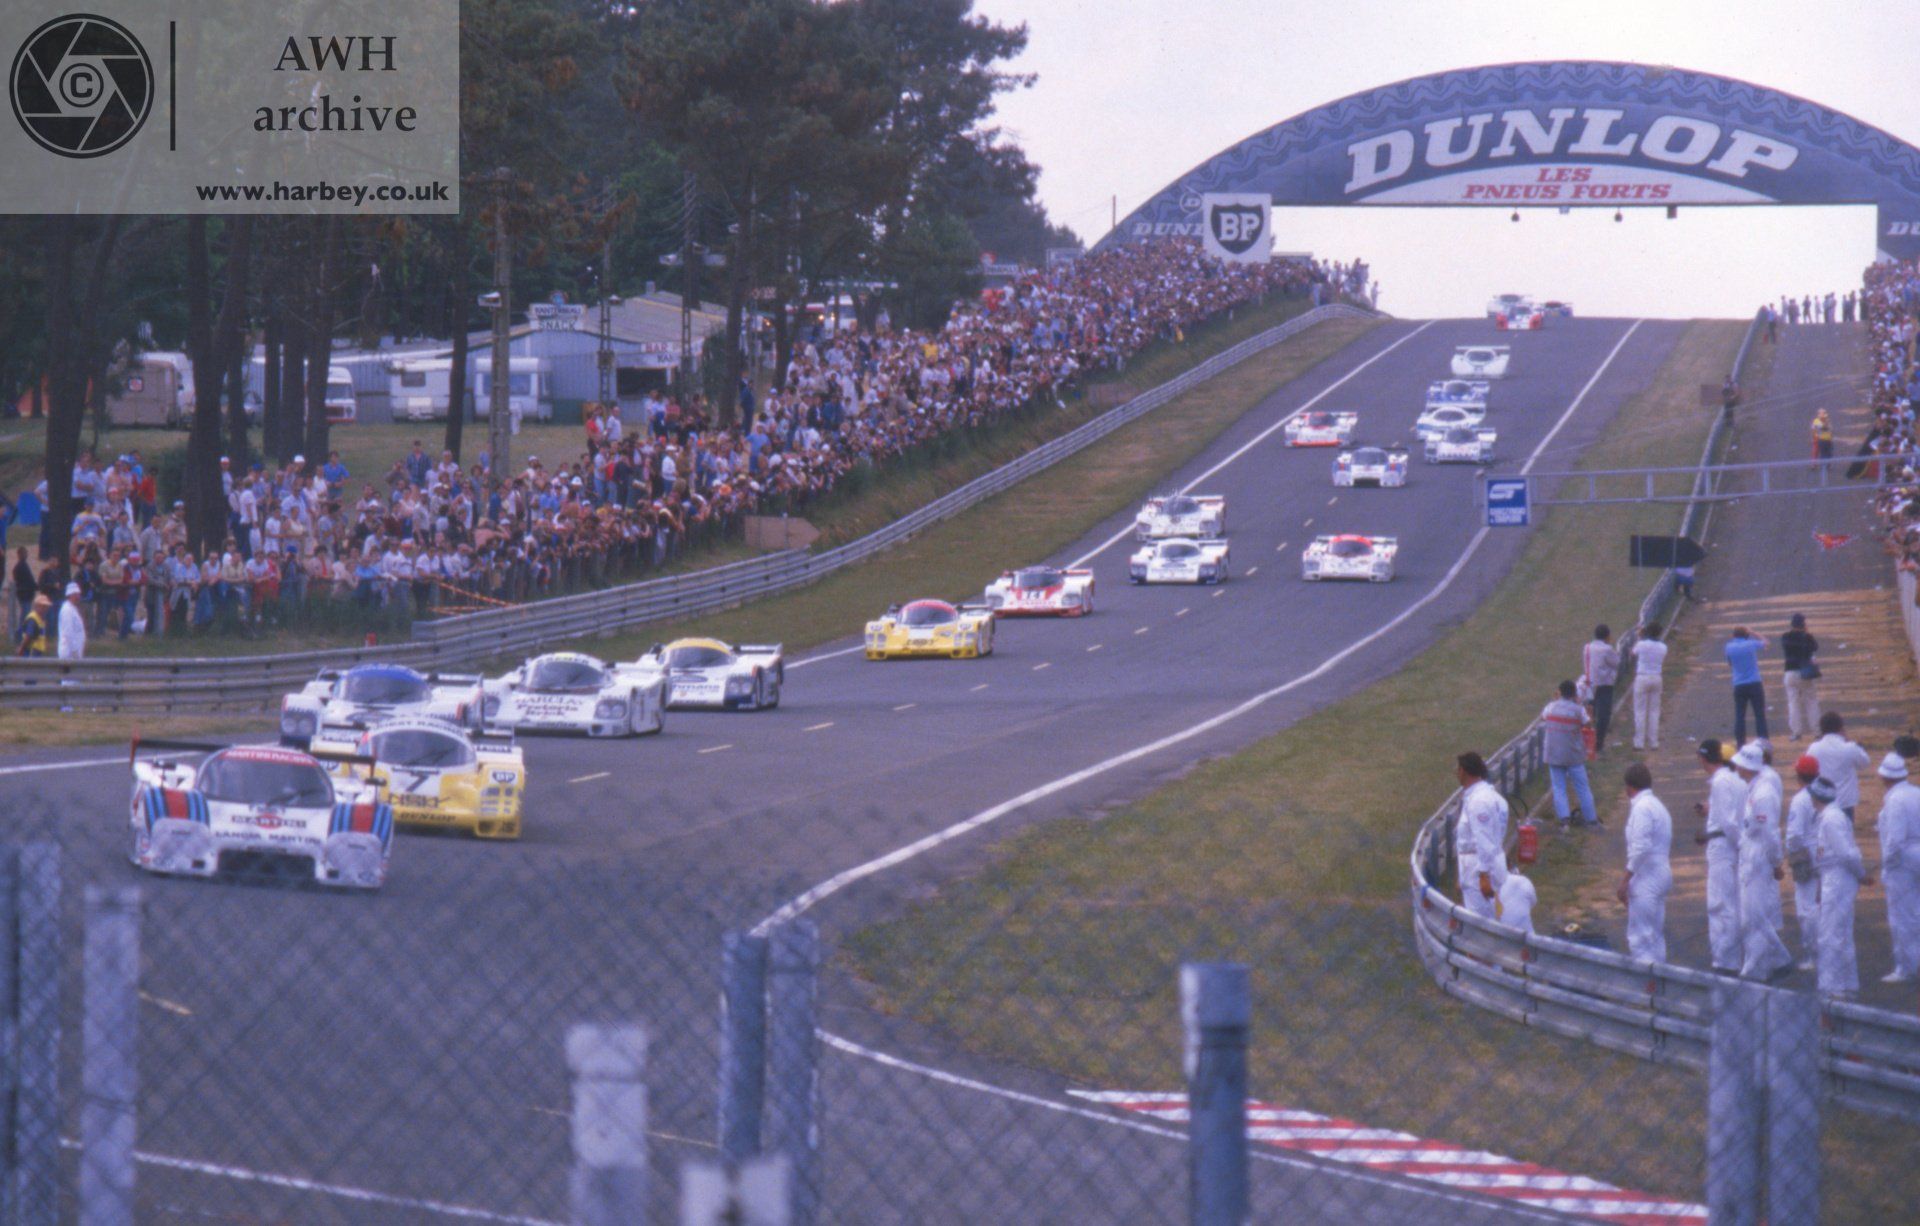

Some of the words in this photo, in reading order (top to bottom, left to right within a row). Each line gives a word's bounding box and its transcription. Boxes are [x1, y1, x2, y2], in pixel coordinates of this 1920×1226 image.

[1344, 108, 1799, 194] DUNLOP
[1536, 168, 1592, 183] LES
[1462, 184, 1569, 199] PNEUS
[1575, 184, 1671, 199] FORTS
[1219, 212, 1261, 242] BP
[538, 320, 576, 331] SNACK
[405, 770, 431, 793] 7
